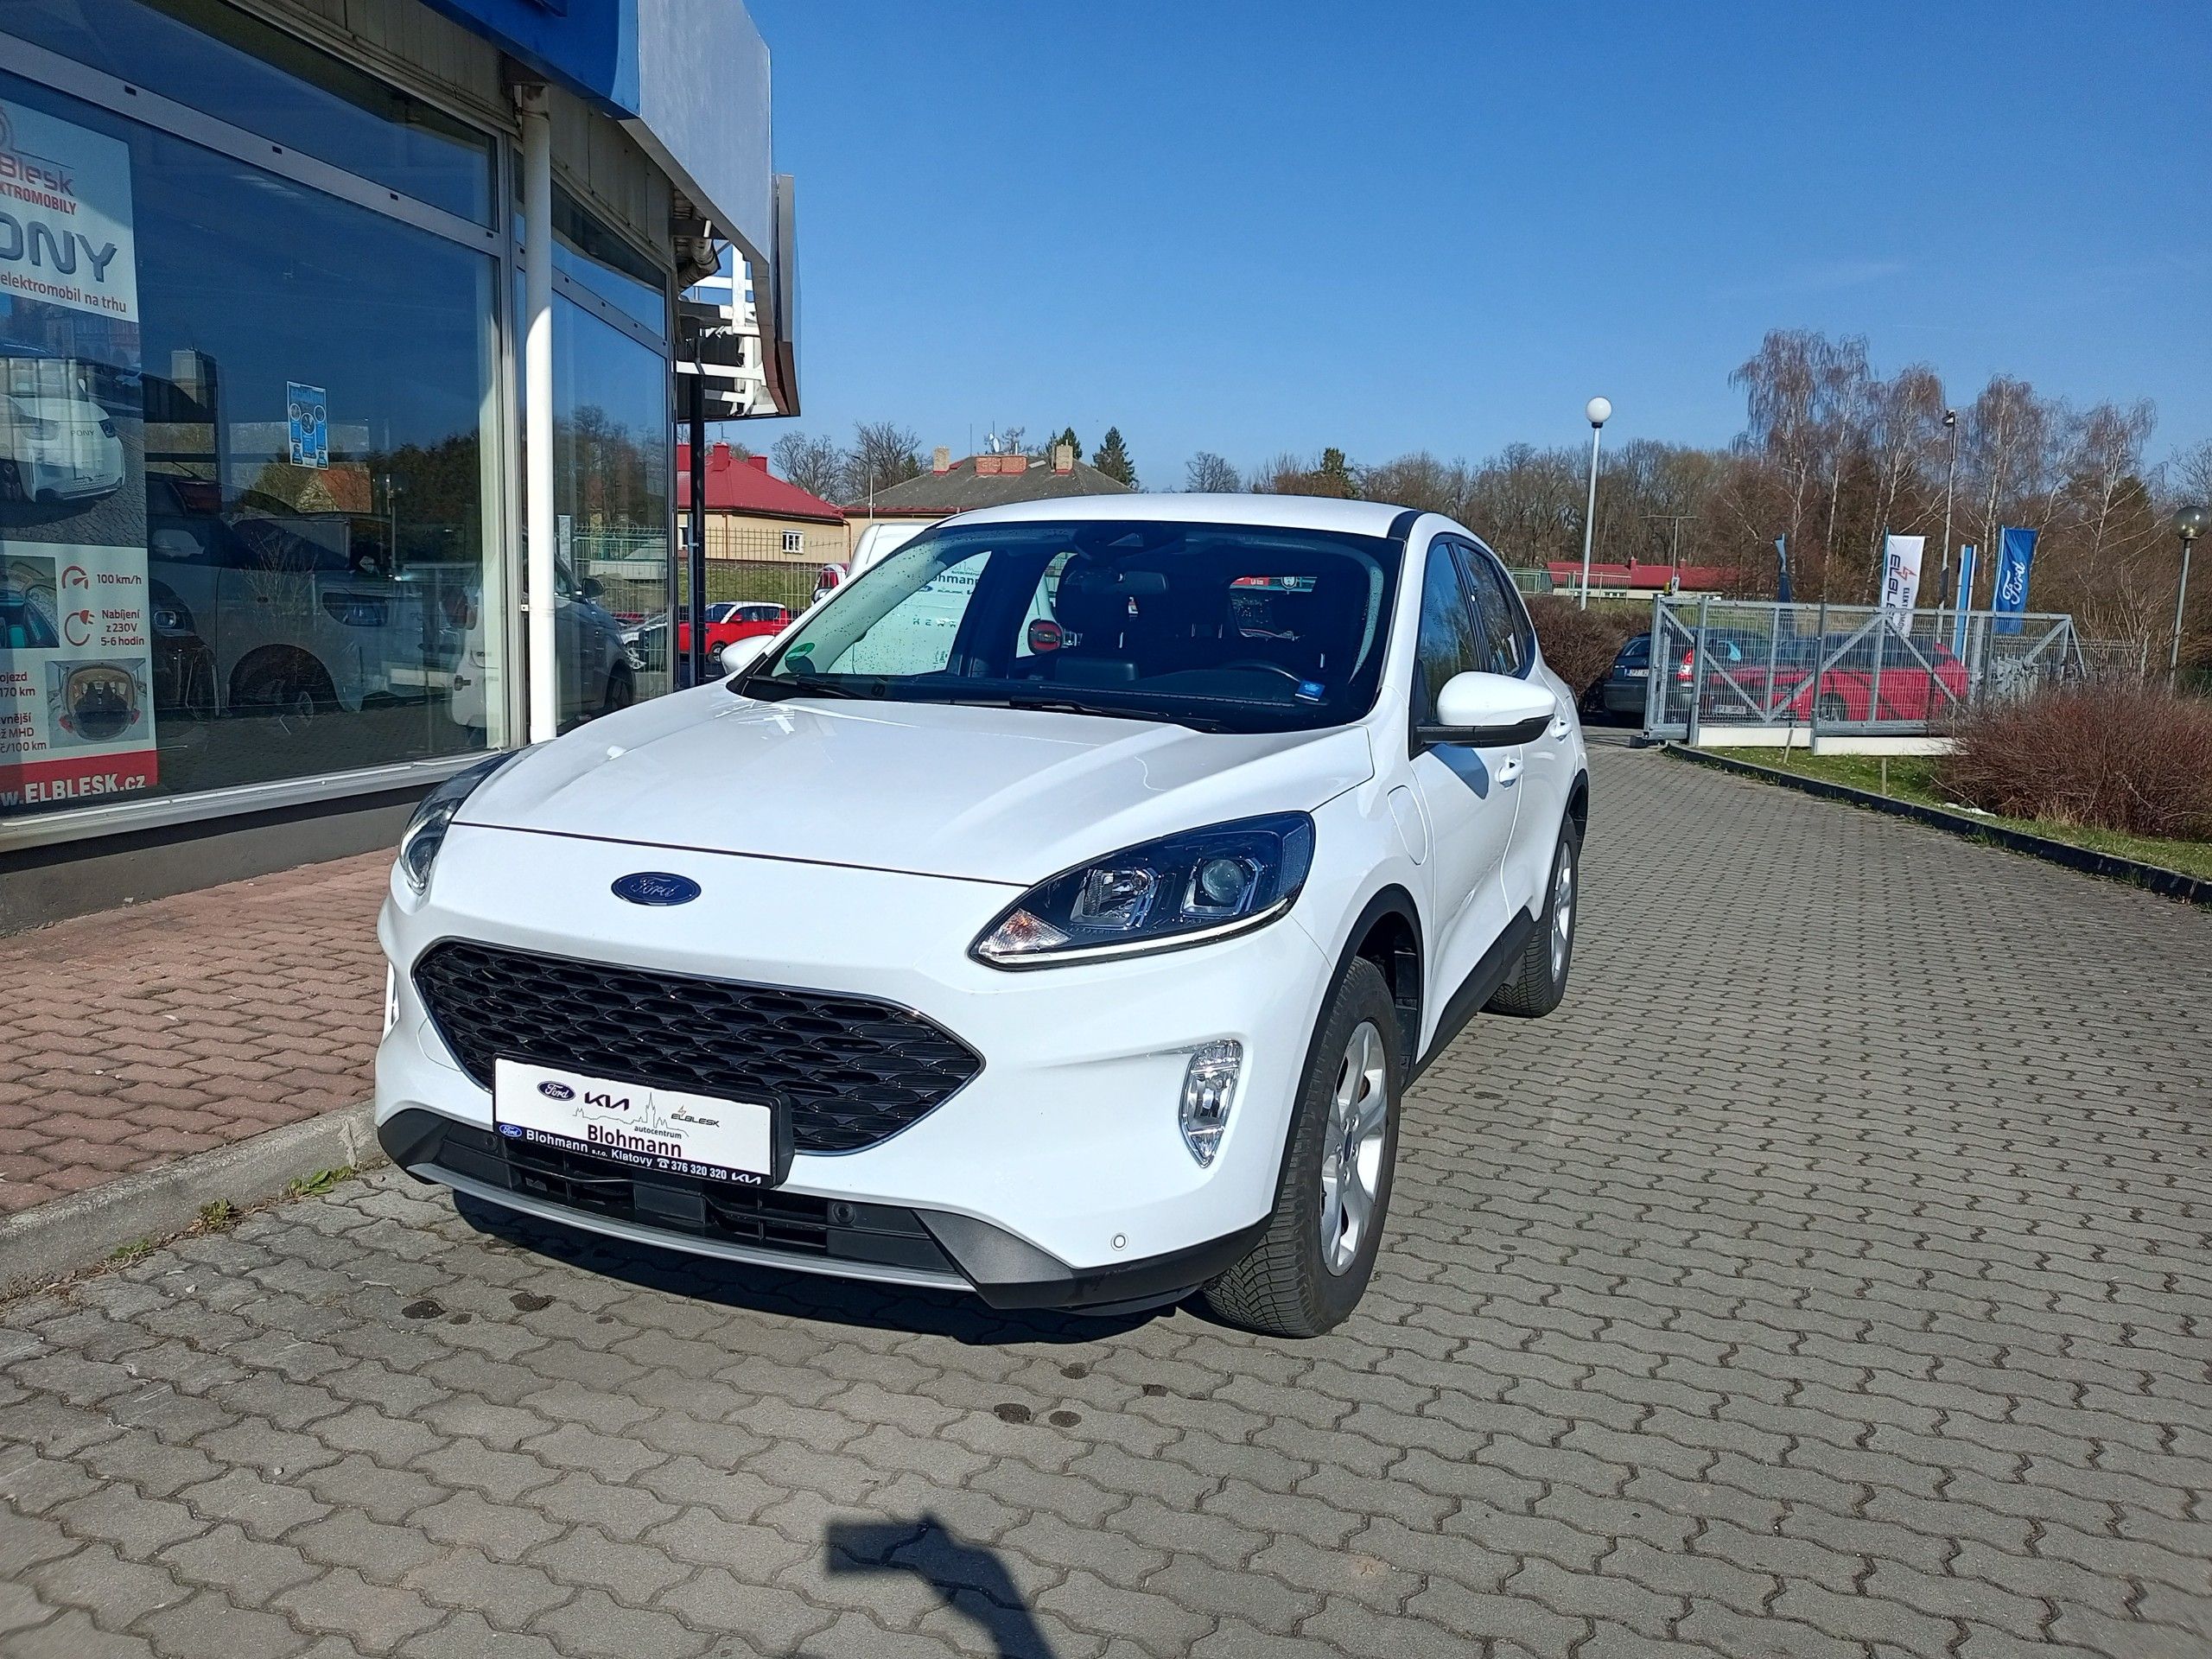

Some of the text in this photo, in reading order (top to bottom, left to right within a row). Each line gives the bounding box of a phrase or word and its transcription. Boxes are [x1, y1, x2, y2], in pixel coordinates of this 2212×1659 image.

[1, 271, 127, 314] elektromobil na trhu
[97, 573, 142, 585] 100 km/h
[2001, 560, 2026, 605] Ford
[101, 608, 141, 621] Nabíjení
[106, 622, 138, 632] z 230V
[100, 635, 145, 646] 5-6 hodin
[20, 686, 35, 696] km
[9, 728, 35, 739] MHD
[32, 741, 47, 750] km
[544, 1083, 569, 1099] Ford
[584, 1091, 630, 1111] KIA
[671, 1113, 720, 1128] ELBLESK
[633, 1125, 683, 1140] autocentrum
[588, 1124, 683, 1158] Blohmann
[526, 1129, 588, 1153] Blohmann
[591, 1147, 608, 1157] s.r.o.
[611, 1148, 653, 1167] Klatovy
[671, 1160, 689, 1173] 376
[690, 1164, 708, 1176] 320
[709, 1168, 728, 1180] 320
